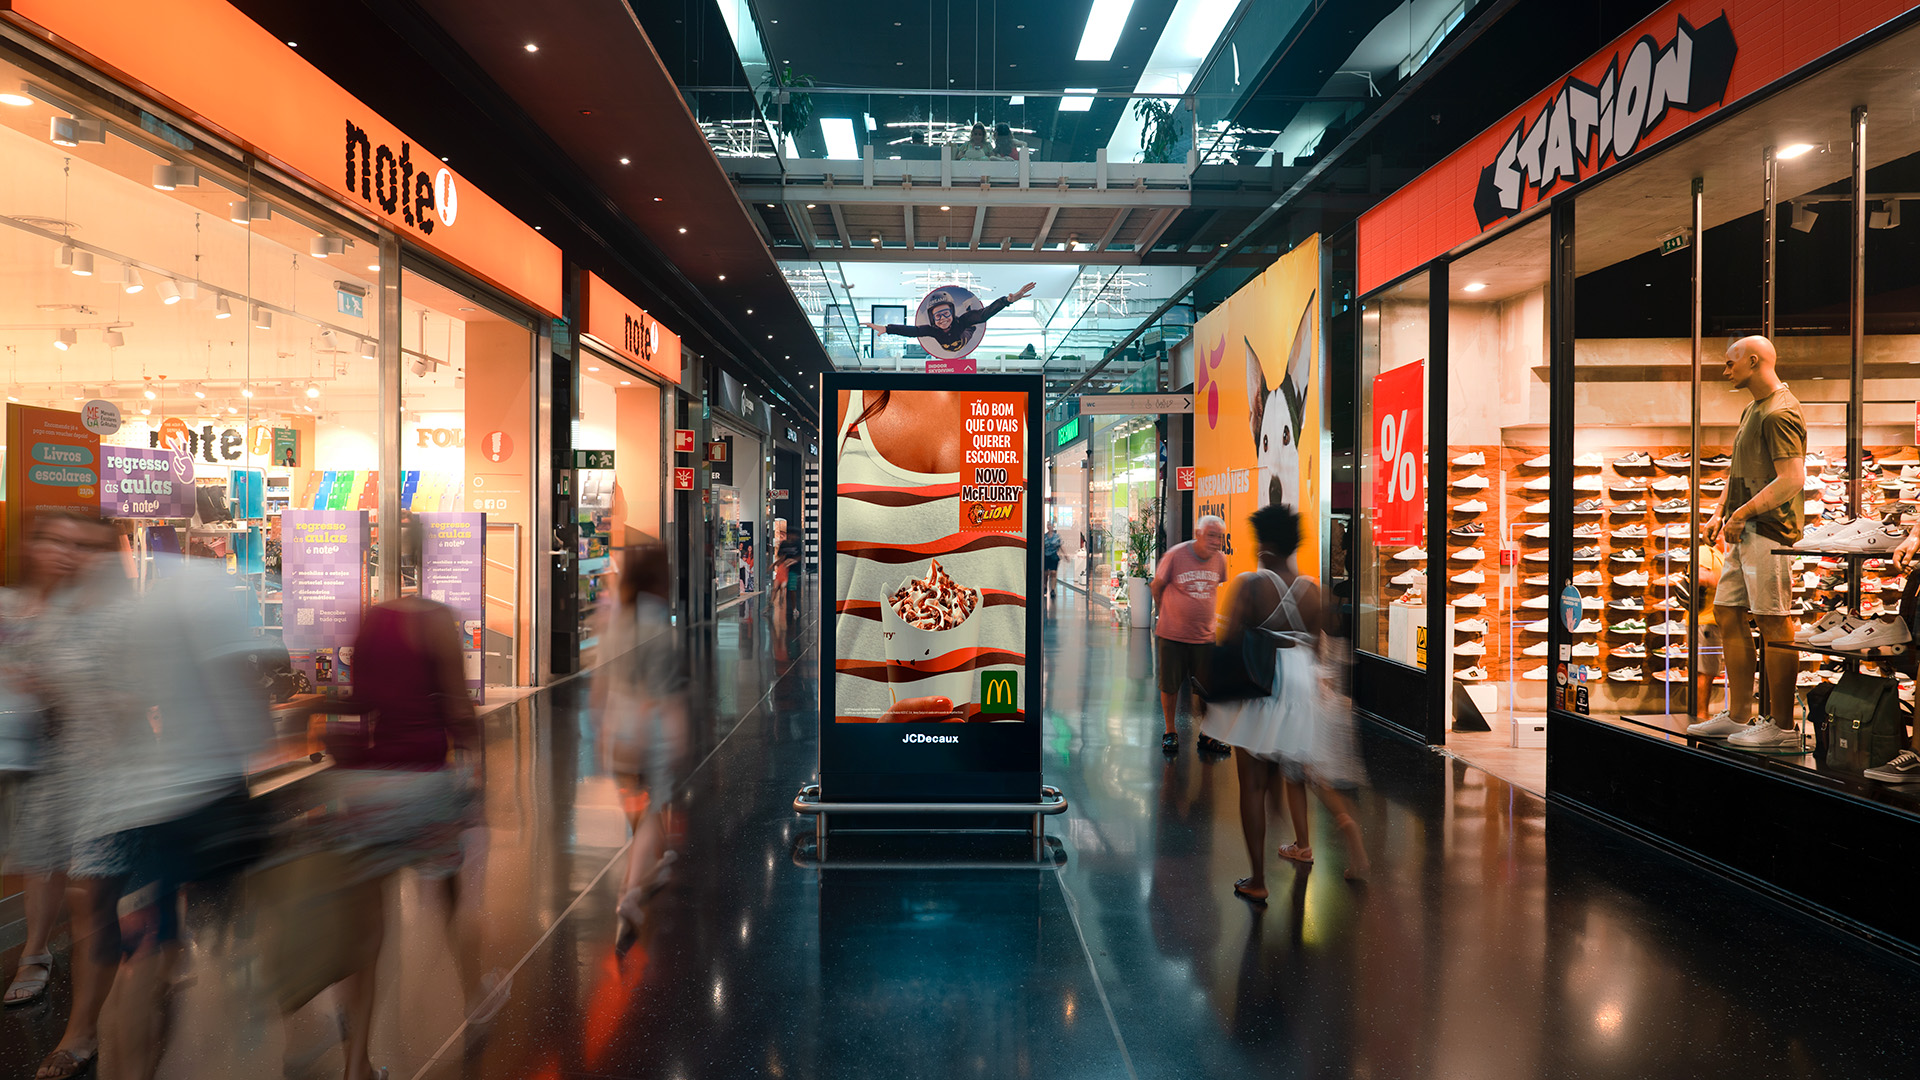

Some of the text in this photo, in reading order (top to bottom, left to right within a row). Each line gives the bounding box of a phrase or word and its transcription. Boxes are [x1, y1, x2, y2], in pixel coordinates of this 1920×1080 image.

[1494, 26, 1693, 210] STATION
[971, 399, 1014, 416] TÃO BOM
[965, 419, 1018, 434] QUE O VAIS
[973, 434, 1011, 450] QUERER
[44, 447, 81, 462] Livros
[966, 450, 1019, 464] ESCONDER.
[107, 456, 169, 474] regresso
[35, 468, 91, 483] escolares
[975, 468, 1008, 484] NOVO
[1198, 466, 1249, 497] INSEPARÁVEIS
[105, 474, 172, 495] às aulas
[123, 501, 129, 512] é
[296, 523, 346, 533] regresso
[431, 522, 470, 530] regresso
[305, 532, 348, 543] aulas
[438, 529, 471, 539] aulas
[902, 733, 959, 744] JCDecaux
